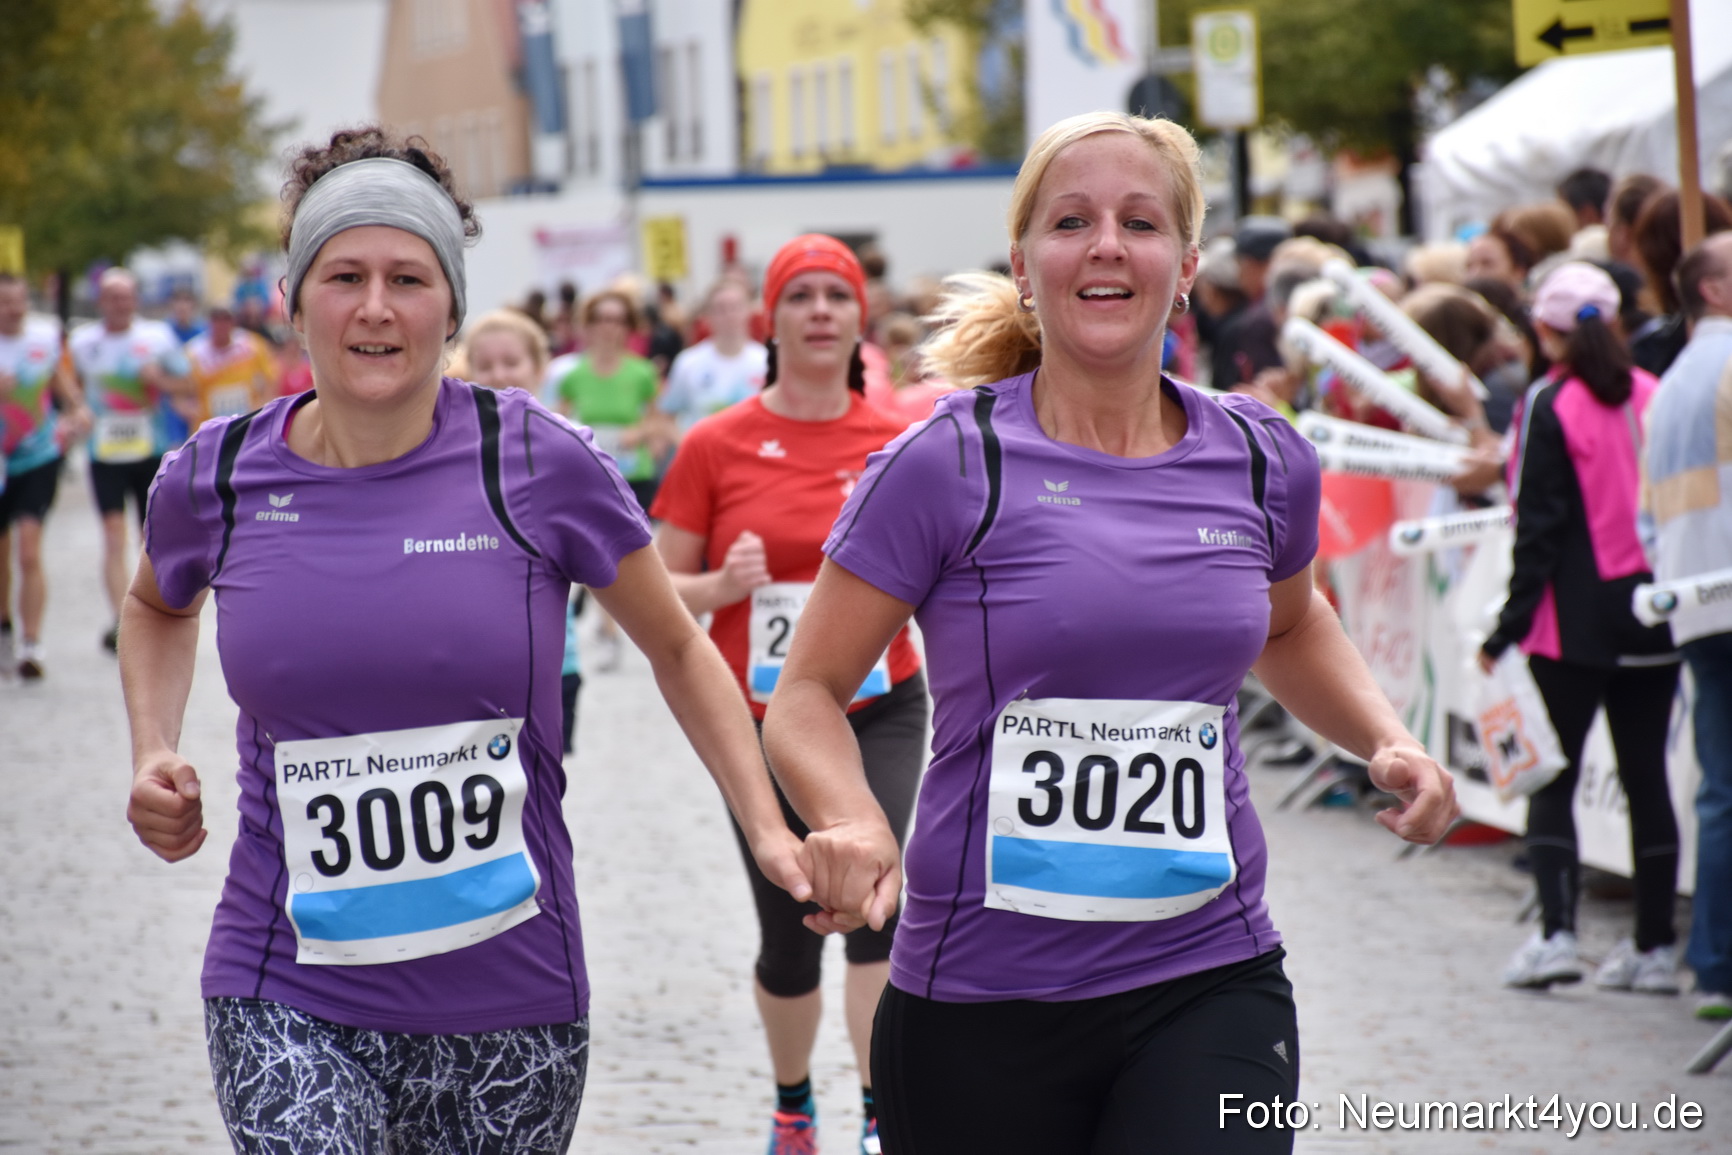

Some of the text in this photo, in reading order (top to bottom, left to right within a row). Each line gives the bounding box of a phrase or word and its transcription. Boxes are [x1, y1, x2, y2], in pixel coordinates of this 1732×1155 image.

[1037, 494, 1081, 506] erima
[255, 510, 299, 522] erima
[403, 532, 499, 554] Bernadette
[1002, 715, 1085, 740] PARTL
[1091, 722, 1192, 744] Neumarkt
[283, 743, 478, 784] PARTL Neumarkt
[1017, 750, 1206, 840] 3020
[306, 773, 505, 878] 3009
